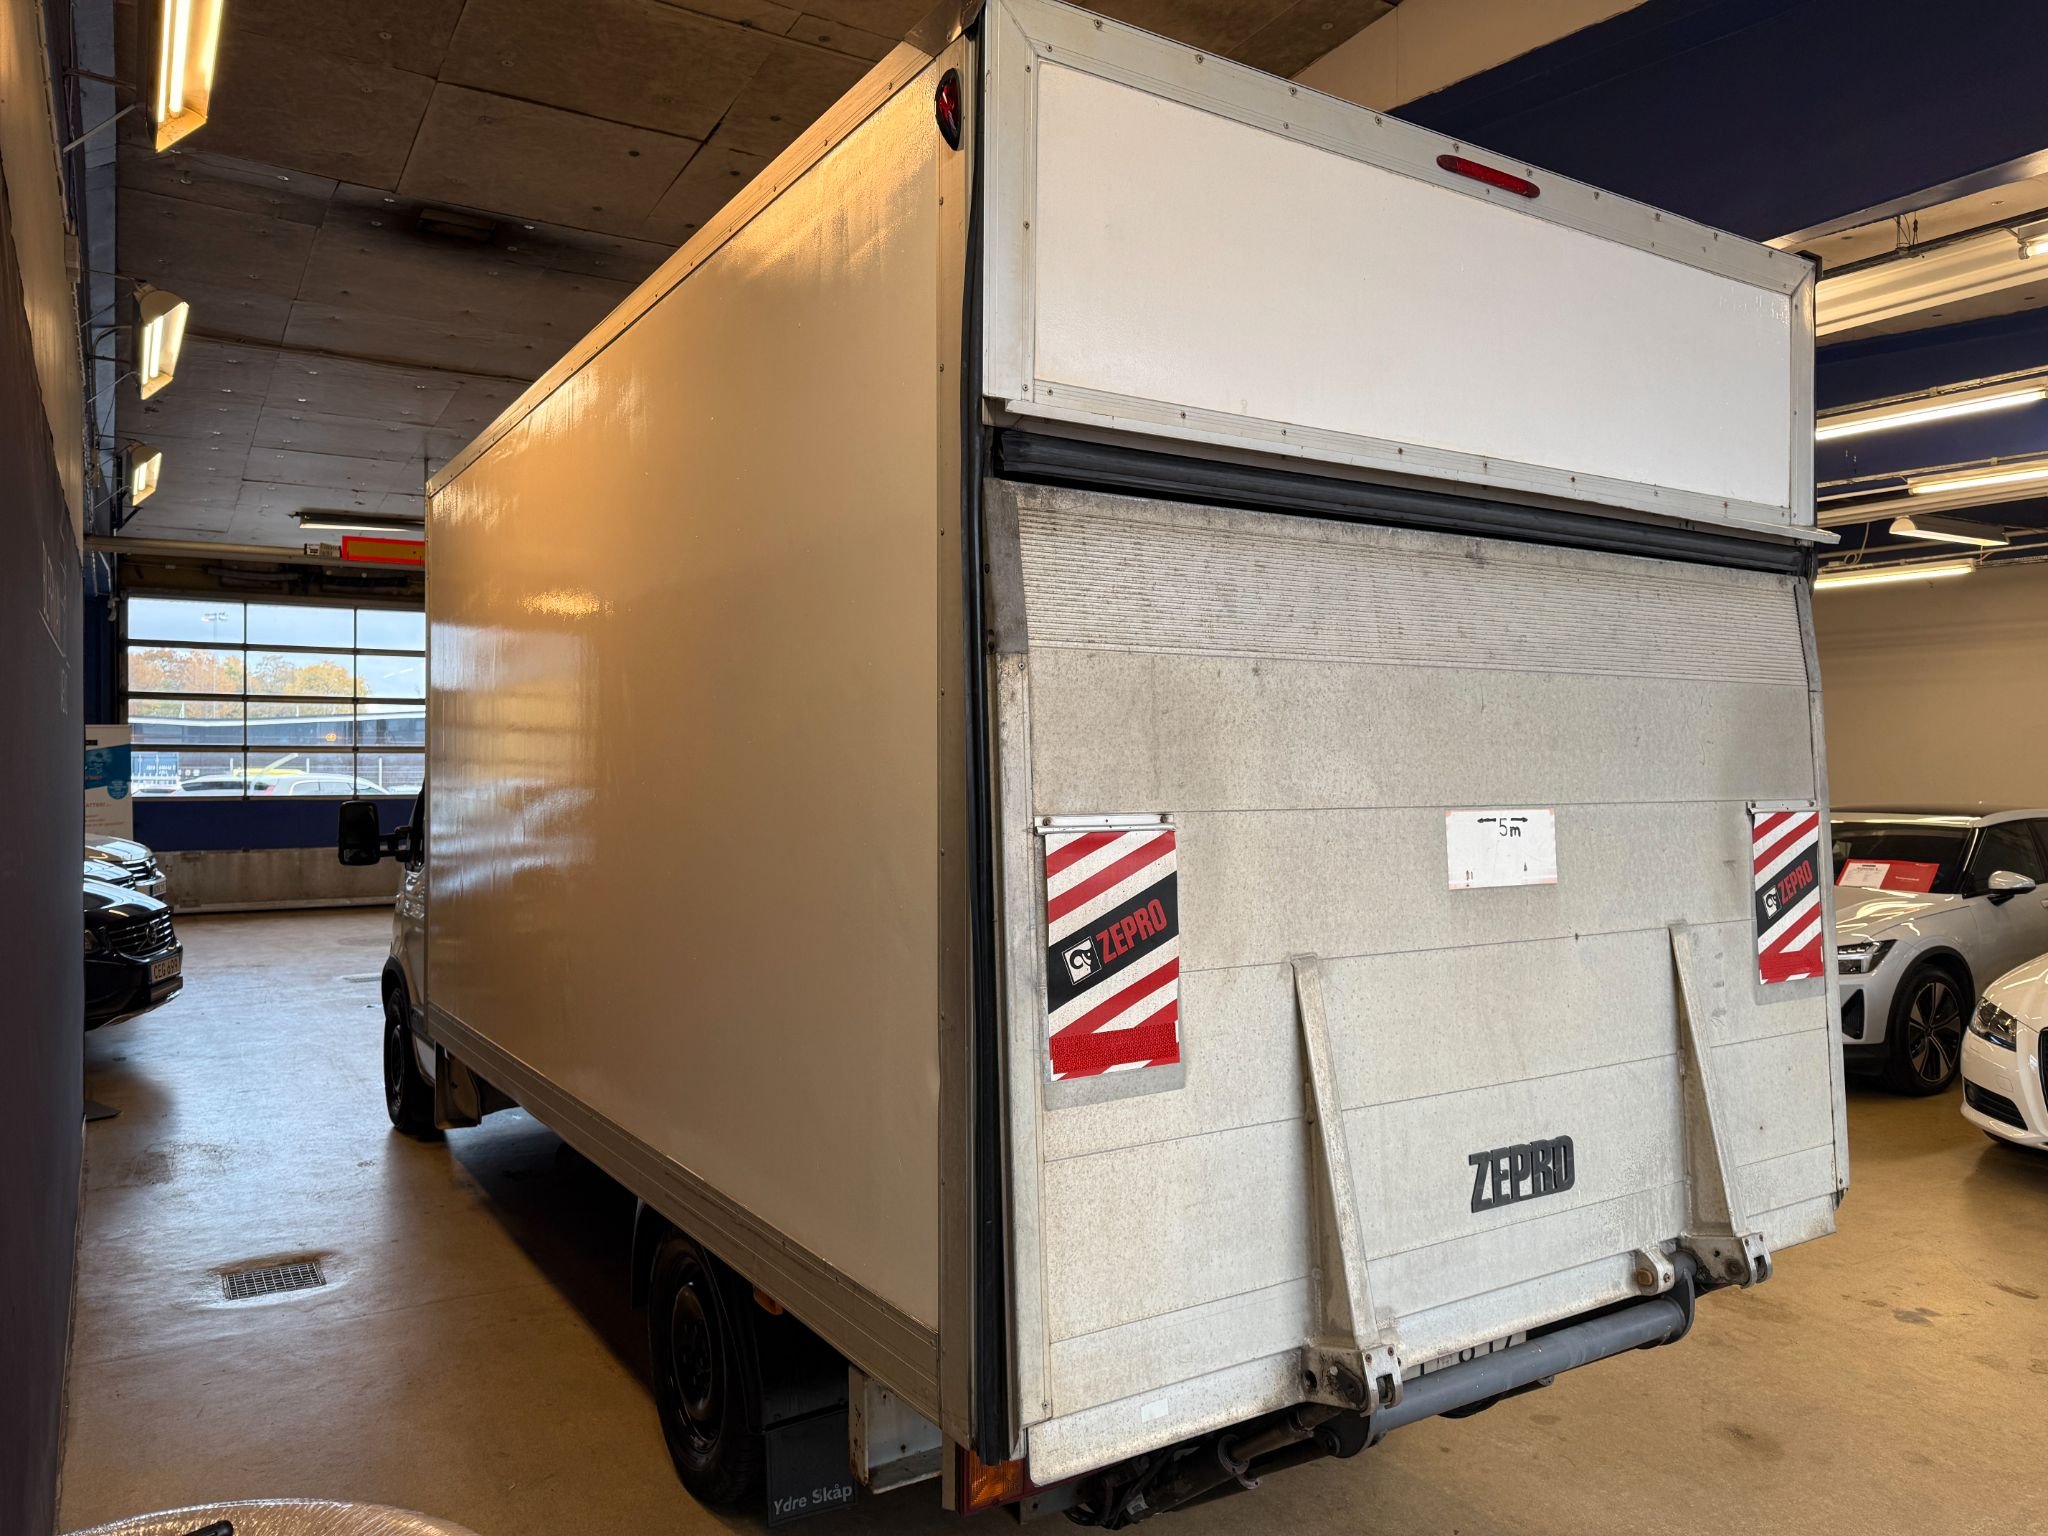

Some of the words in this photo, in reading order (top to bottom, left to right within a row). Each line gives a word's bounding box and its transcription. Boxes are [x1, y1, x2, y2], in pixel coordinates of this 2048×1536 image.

[1777, 860, 1813, 905] ZEPRO
[1095, 899, 1168, 964] ZEPRO
[1468, 1135, 1575, 1213] ZEPRO
[774, 1496, 807, 1515] Ydre
[812, 1484, 852, 1503] Skåp
